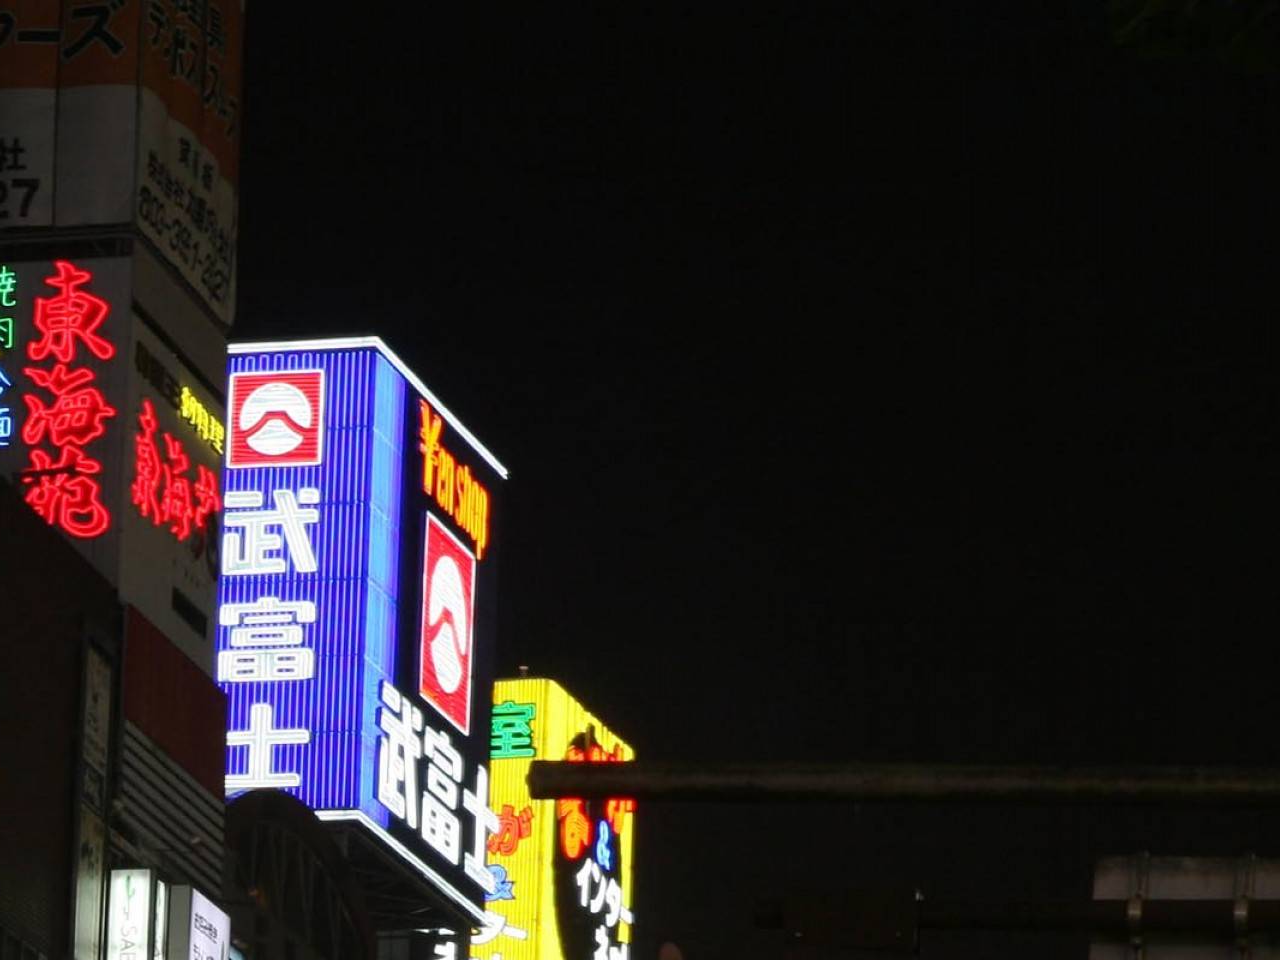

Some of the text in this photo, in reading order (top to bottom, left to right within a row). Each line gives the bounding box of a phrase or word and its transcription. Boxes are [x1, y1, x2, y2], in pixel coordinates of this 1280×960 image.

[221, 488, 320, 795] 武富士
[379, 681, 498, 893] 武富士
